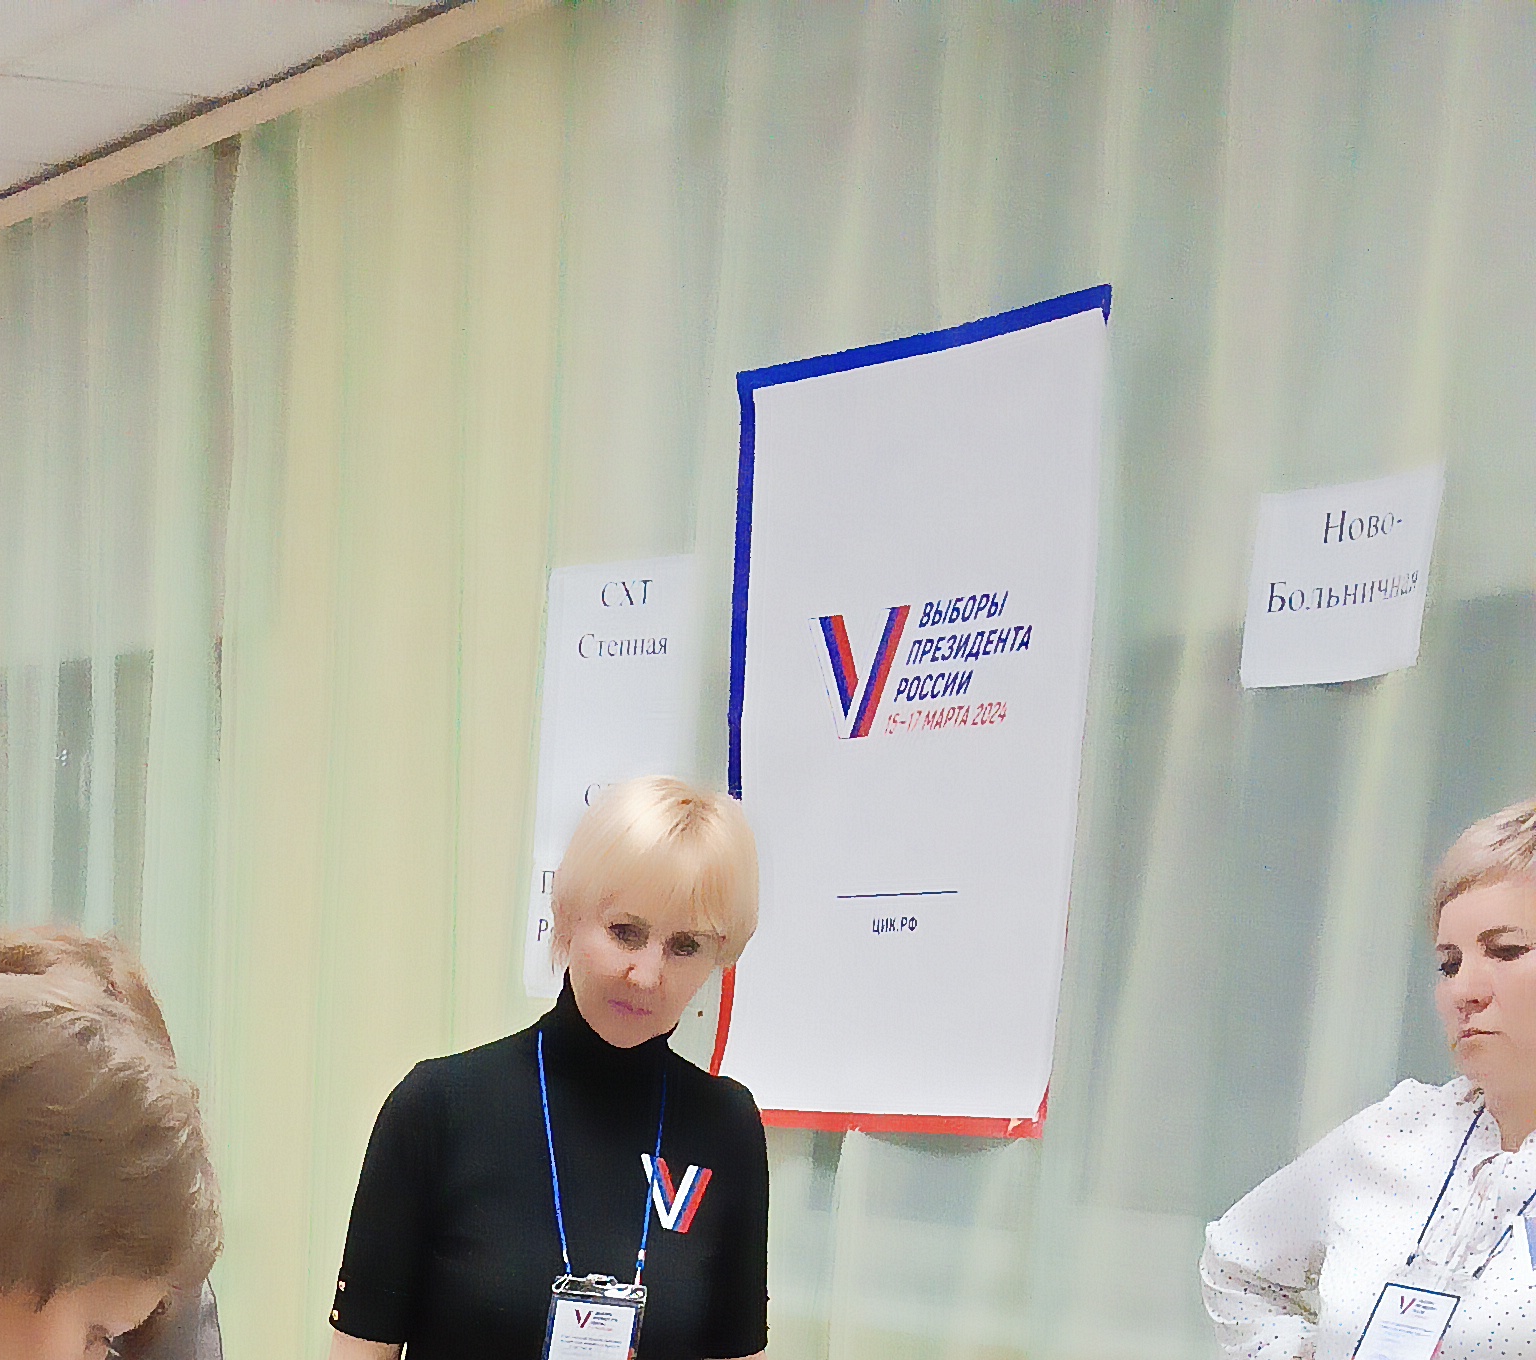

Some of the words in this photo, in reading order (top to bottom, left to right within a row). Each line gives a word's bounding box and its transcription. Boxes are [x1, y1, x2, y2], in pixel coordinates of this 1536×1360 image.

[1322, 510, 1403, 544] Ново-
[601, 579, 654, 608] СХТ
[918, 590, 1009, 629] ВЫБОРЫ
[578, 632, 669, 659] Степная
[905, 625, 1033, 665] ПРЕЗИДЕНТА
[893, 669, 974, 702] РОССИИ
[921, 704, 971, 731] МАРТА
[970, 701, 1008, 726] 2024
[872, 916, 918, 935] ЦИК.РФ
